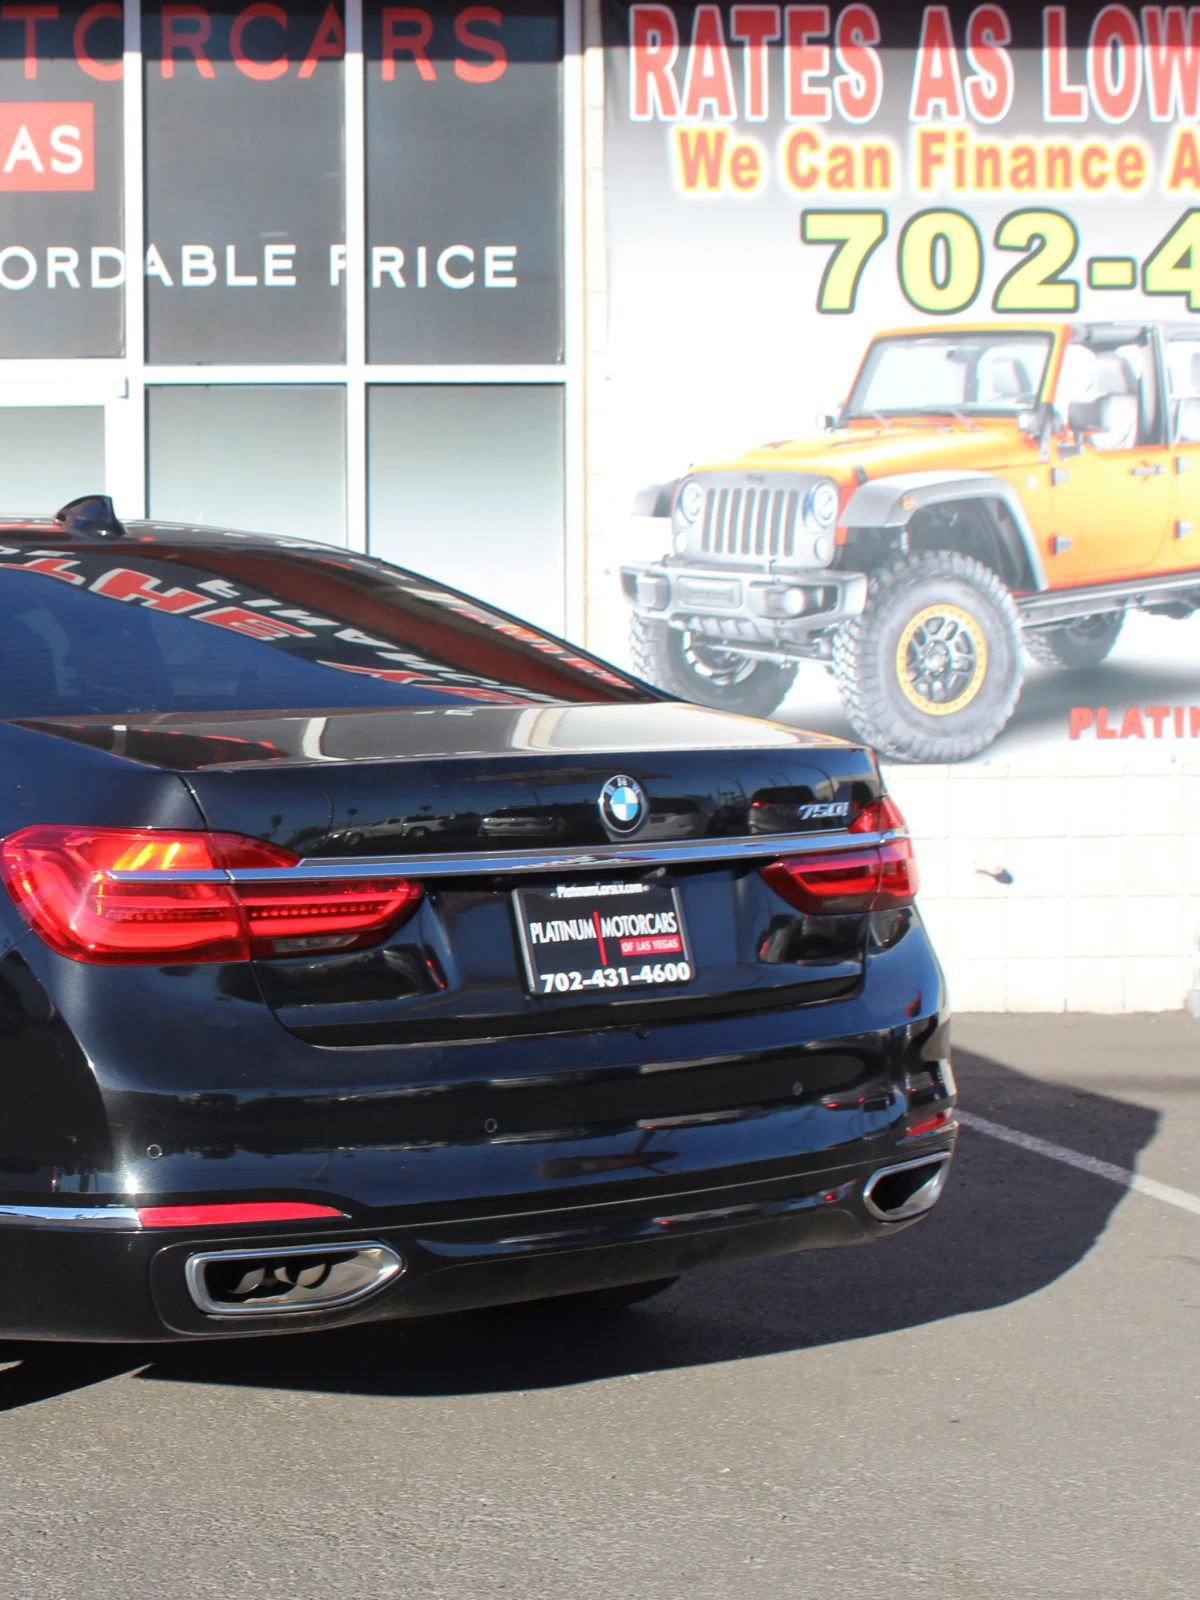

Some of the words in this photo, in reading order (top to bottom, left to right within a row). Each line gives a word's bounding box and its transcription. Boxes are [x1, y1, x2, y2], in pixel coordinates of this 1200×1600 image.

[629, 4, 884, 123] RATES
[909, 4, 1015, 123] AS
[1042, 4, 1200, 124] LOW
[676, 129, 761, 191] We
[785, 130, 892, 191] Can
[918, 129, 1146, 191] Finance
[529, 918, 596, 944] PLATINUM
[601, 912, 677, 938] MOTORCARS
[621, 940, 634, 952] OF
[636, 940, 651, 951] LAS
[653, 938, 679, 951] VEGAS
[540, 962, 691, 993] 702-431-4600
